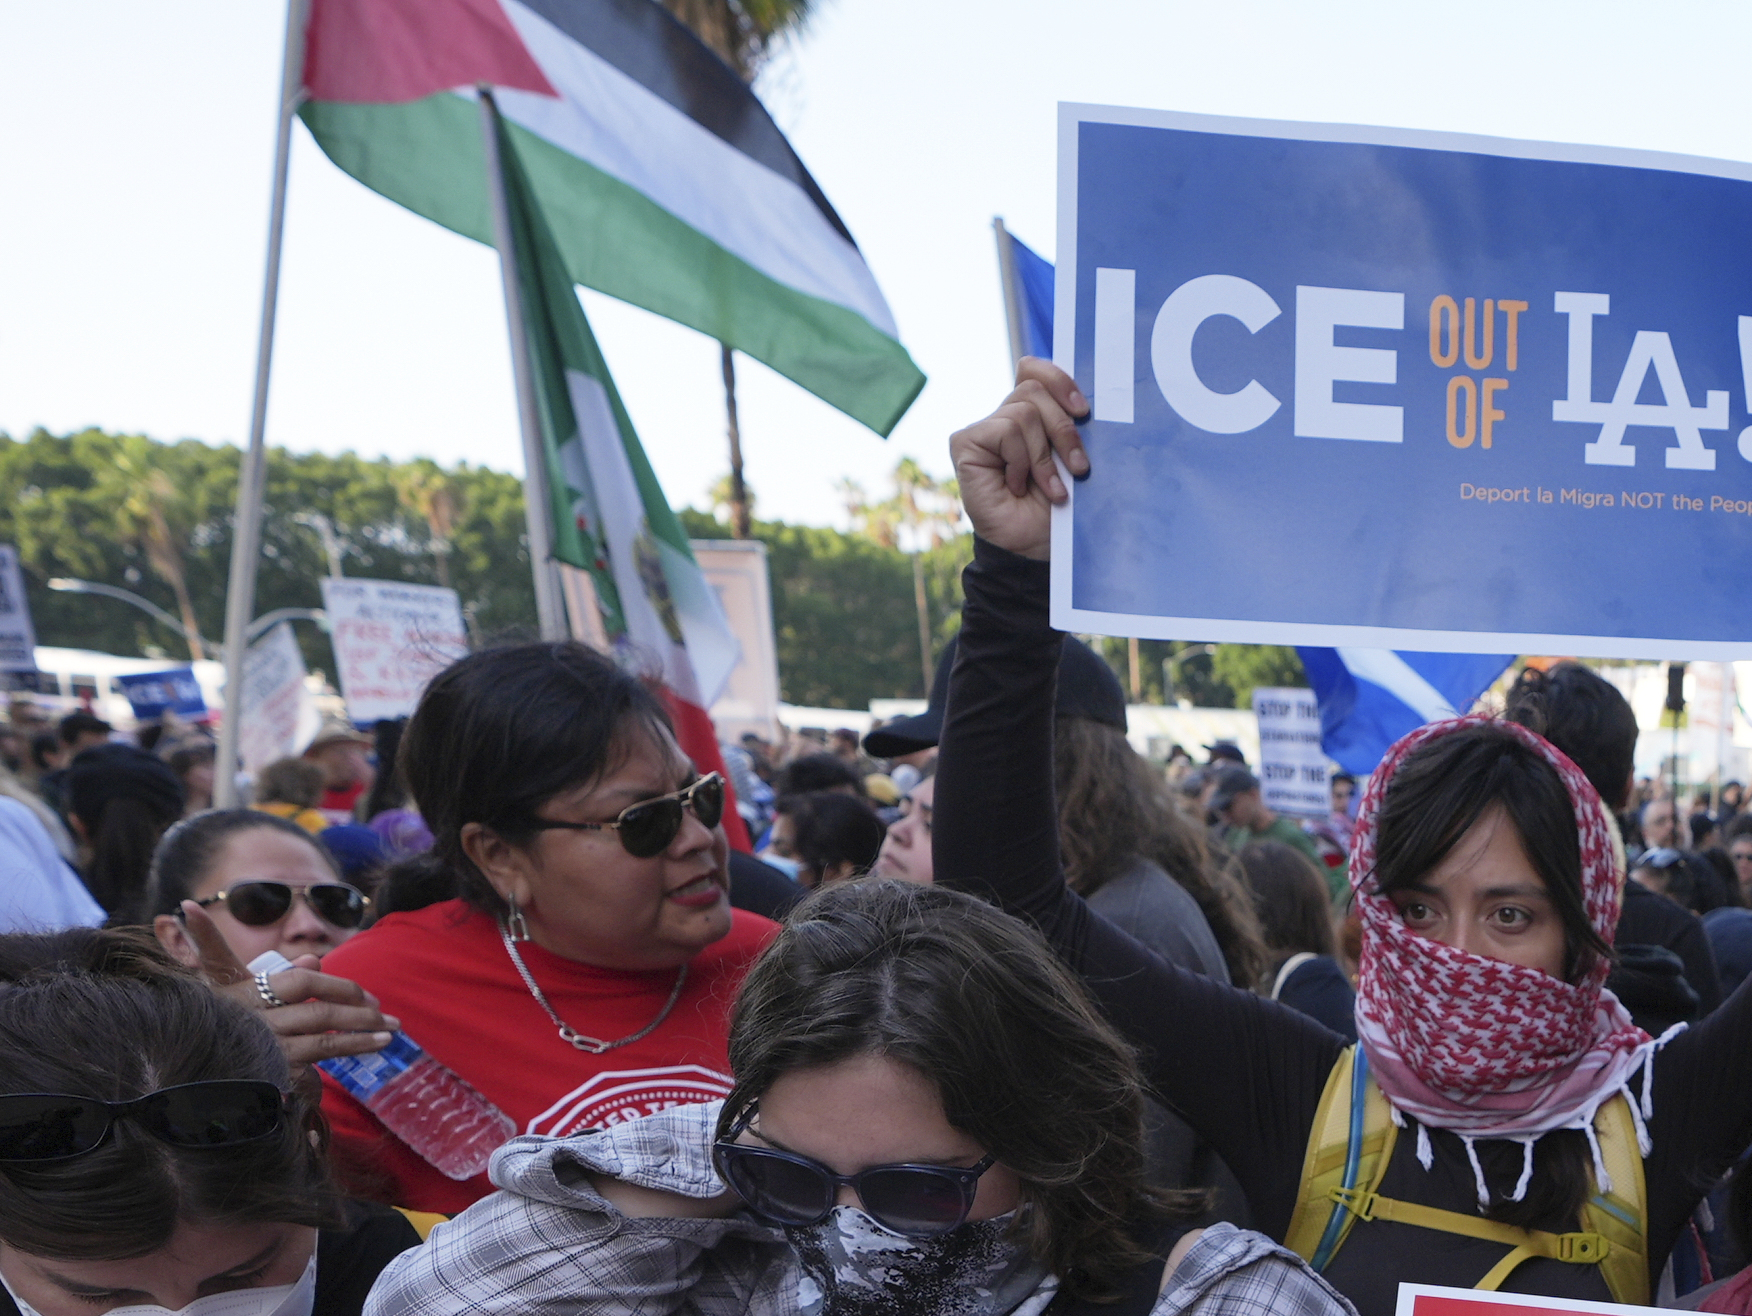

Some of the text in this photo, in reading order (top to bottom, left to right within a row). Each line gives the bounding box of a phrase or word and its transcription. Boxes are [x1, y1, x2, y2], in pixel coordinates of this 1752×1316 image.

[1094, 266, 1404, 443] ICE
[1428, 293, 1528, 372] OUT
[1445, 374, 1509, 450] OF
[1459, 482, 1531, 504] Deport
[1537, 486, 1553, 503] la
[1560, 488, 1615, 509] Migra
[1621, 491, 1666, 510] NOT
[1672, 494, 1704, 511] the
[1260, 700, 1290, 717] STOP
[1266, 763, 1295, 780] STOP
